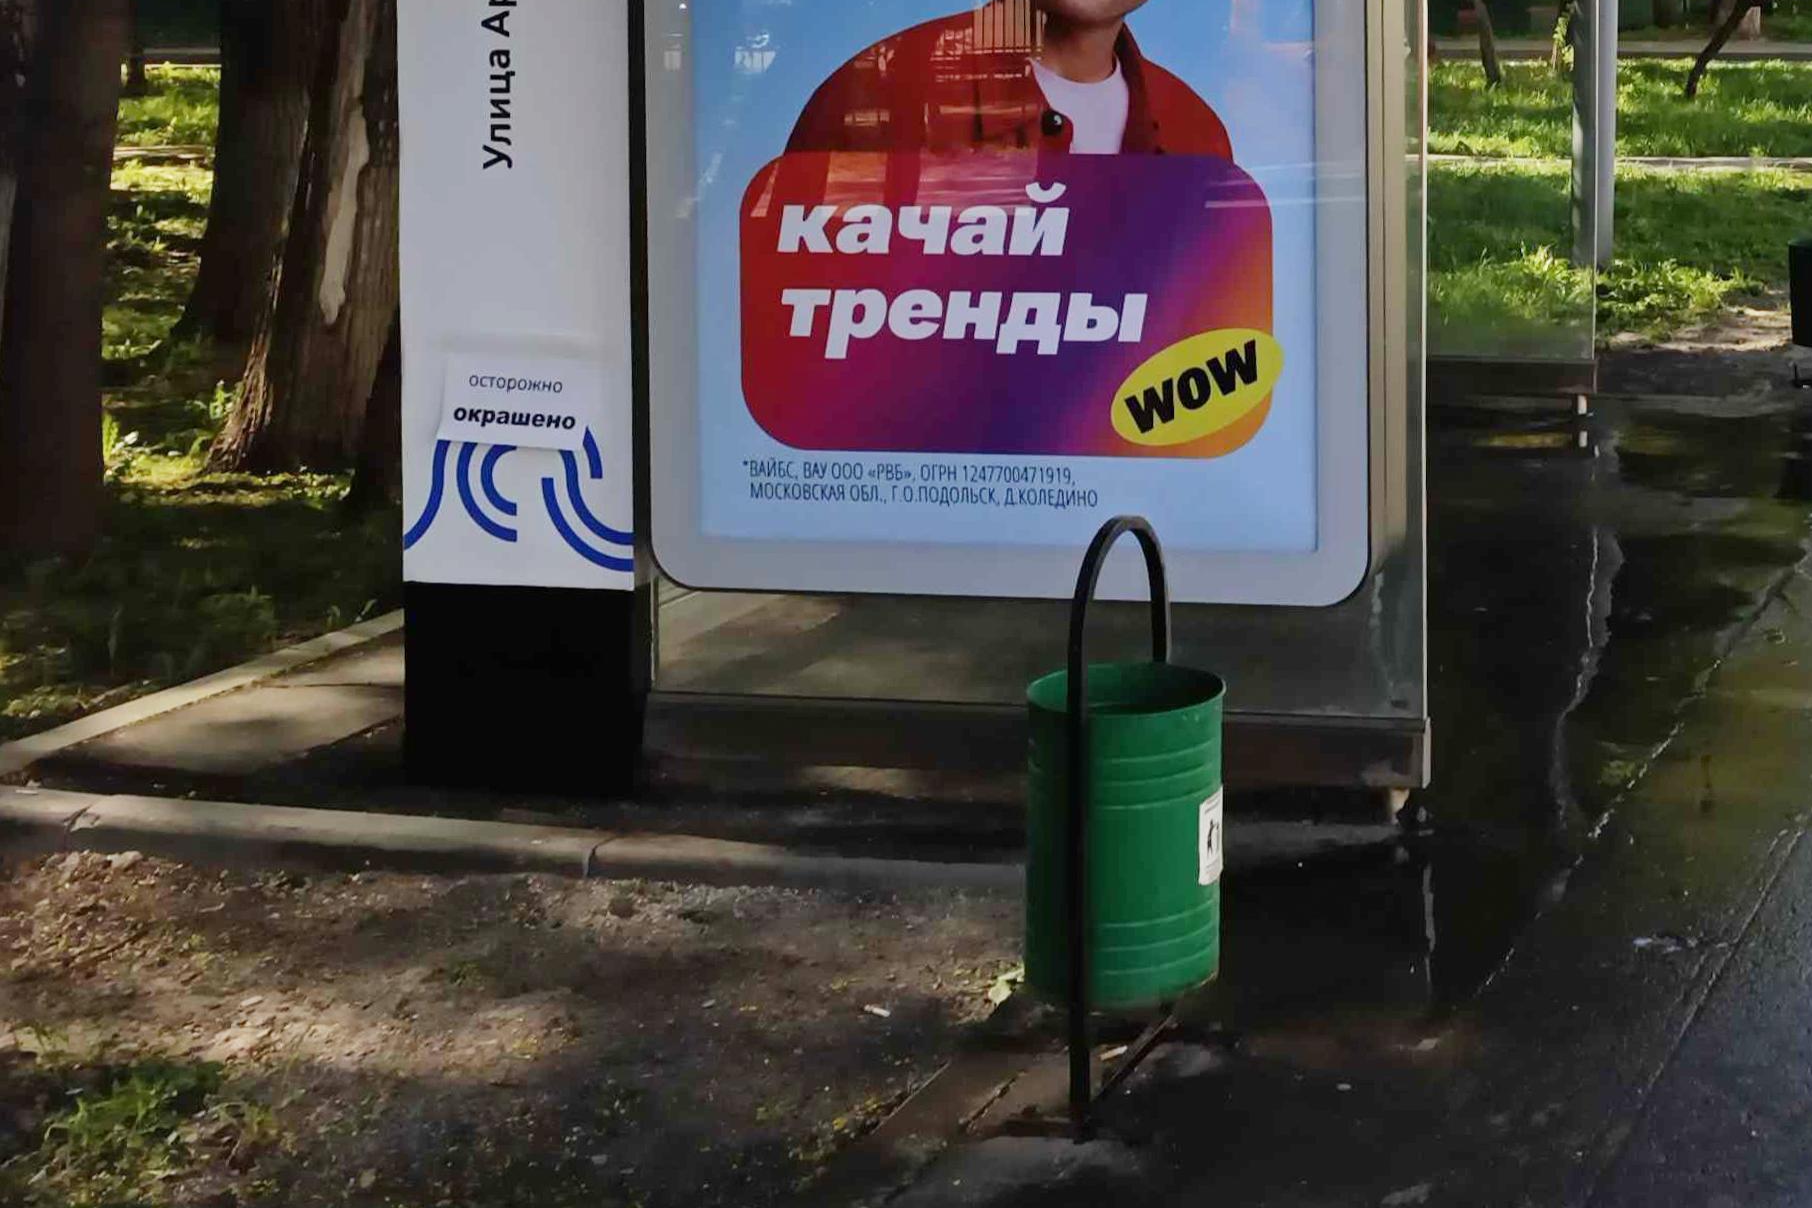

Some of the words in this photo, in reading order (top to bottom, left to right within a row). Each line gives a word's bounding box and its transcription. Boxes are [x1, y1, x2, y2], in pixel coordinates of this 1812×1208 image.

[482, 48, 515, 169] Улица
[777, 182, 1069, 258] качай
[781, 287, 1148, 359] тренды
[469, 374, 563, 393] осторожно
[453, 405, 576, 430] окрашено
[803, 461, 827, 479] ВАУ
[831, 463, 864, 480] ООО
[868, 464, 916, 481] «РВБ»,
[920, 464, 957, 481] ОГРН
[963, 465, 1076, 486] 1247700471919,
[750, 482, 845, 501] МОСКОВСКАЯ
[850, 484, 887, 504] ОБЛ.,
